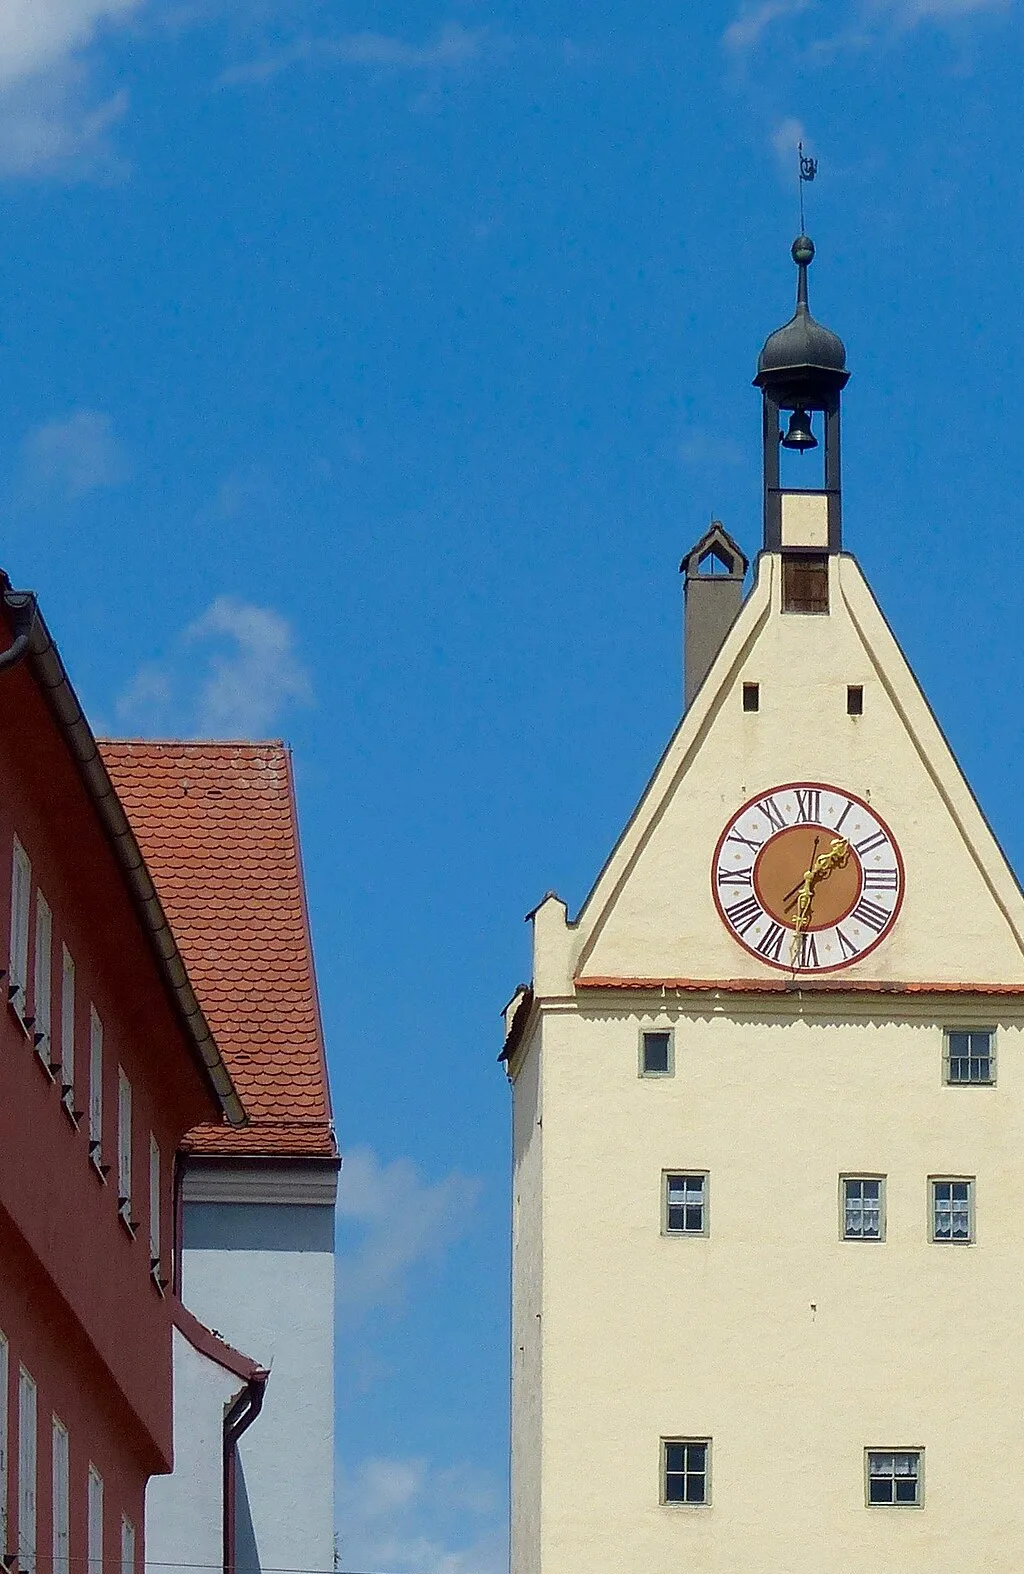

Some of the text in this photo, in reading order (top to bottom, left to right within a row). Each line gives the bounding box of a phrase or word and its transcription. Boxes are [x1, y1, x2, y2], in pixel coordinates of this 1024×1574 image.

[756, 796, 789, 834] XI
[794, 789, 822, 824] XII
[834, 800, 855, 832] I
[727, 827, 764, 854] X
[852, 829, 889, 858] II
[718, 866, 753, 887] IX
[863, 867, 898, 891] III
[725, 895, 763, 938] VIII
[851, 896, 892, 934] IIII
[754, 921, 787, 962] VII
[836, 926, 860, 960] V
